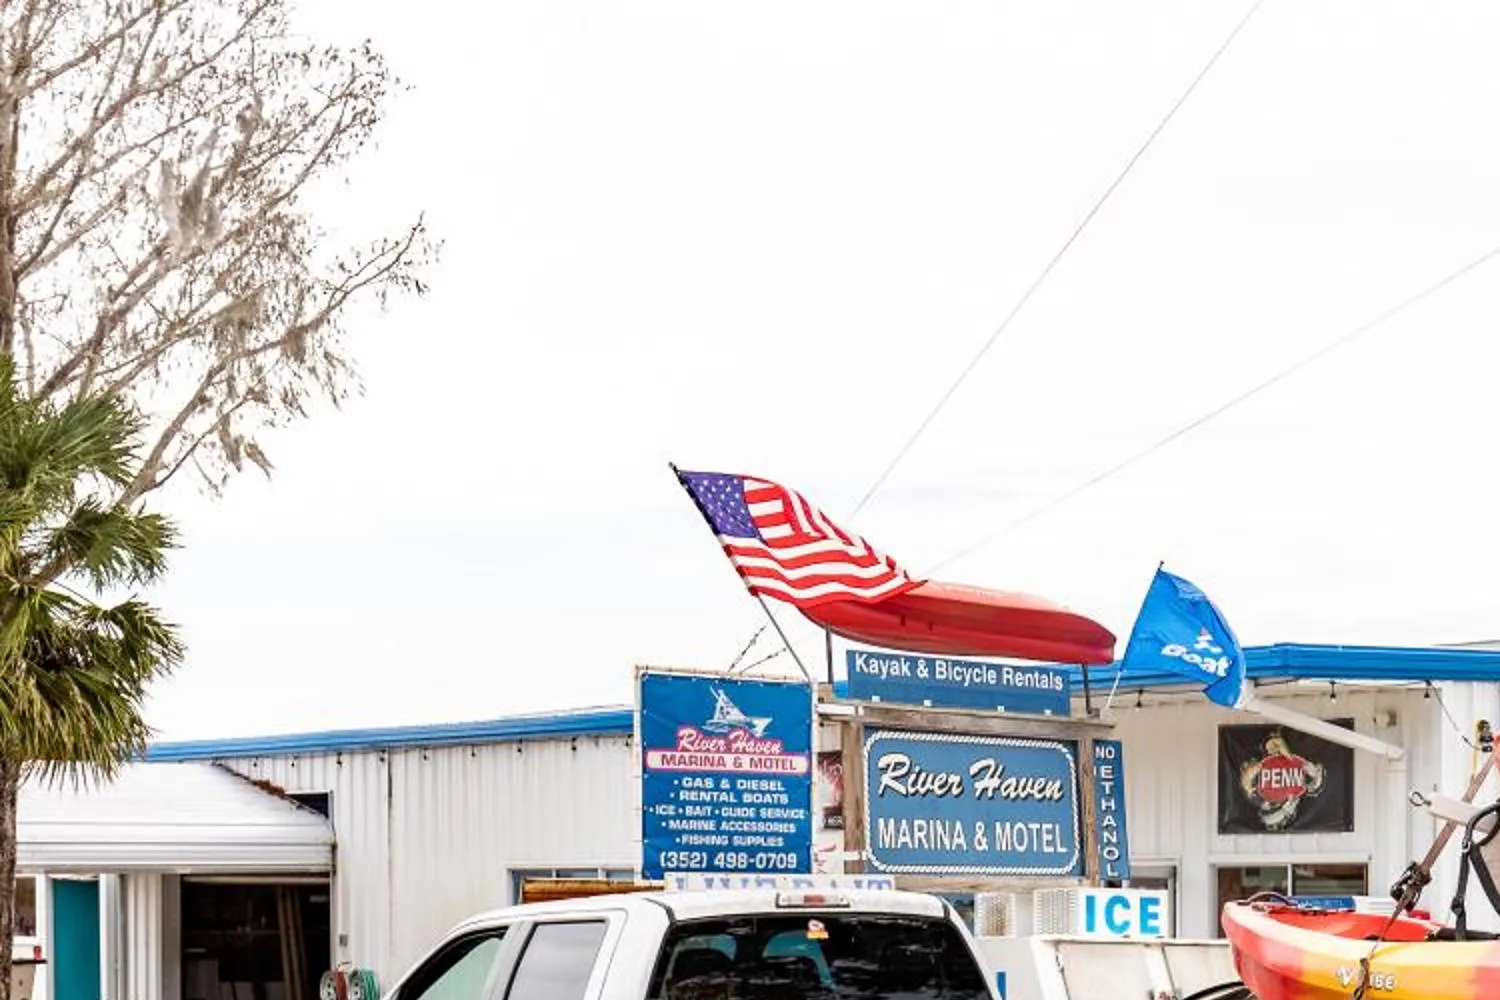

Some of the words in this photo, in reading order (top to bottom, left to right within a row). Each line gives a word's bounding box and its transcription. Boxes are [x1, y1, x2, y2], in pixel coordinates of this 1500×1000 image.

[854, 653, 912, 681] Kayak
[916, 659, 930, 678] &
[935, 660, 998, 687] Bicycle
[1002, 667, 1064, 691] Rentals
[677, 728, 727, 753] River
[728, 730, 783, 755] Haven
[661, 754, 727, 768] MARINA
[732, 756, 744, 769] &
[749, 758, 797, 770] MOTEL
[1095, 746, 1116, 760] NO
[681, 777, 714, 789] GAS
[719, 779, 731, 790] &
[736, 779, 786, 791] DIESEL
[877, 753, 963, 797] River
[969, 758, 1064, 800] Haven
[1261, 768, 1304, 789] PENN
[679, 791, 737, 803] RENTAL
[742, 792, 789, 805] BOATS
[655, 805, 676, 816] ICE
[685, 806, 712, 817] BAIT
[721, 807, 755, 818] GUIDE
[668, 820, 717, 832] MARINE
[719, 821, 797, 833] ACCESSORIES
[1099, 765, 1121, 877] ETHANOL
[681, 834, 729, 846] FISHING
[732, 835, 785, 847] SUPPLIES
[878, 818, 967, 851] MARINA
[973, 822, 989, 851] &
[995, 823, 1068, 853] MOTEL
[658, 851, 708, 869] (352)
[713, 852, 798, 869] 498-0709
[1085, 894, 1161, 935] ICE
